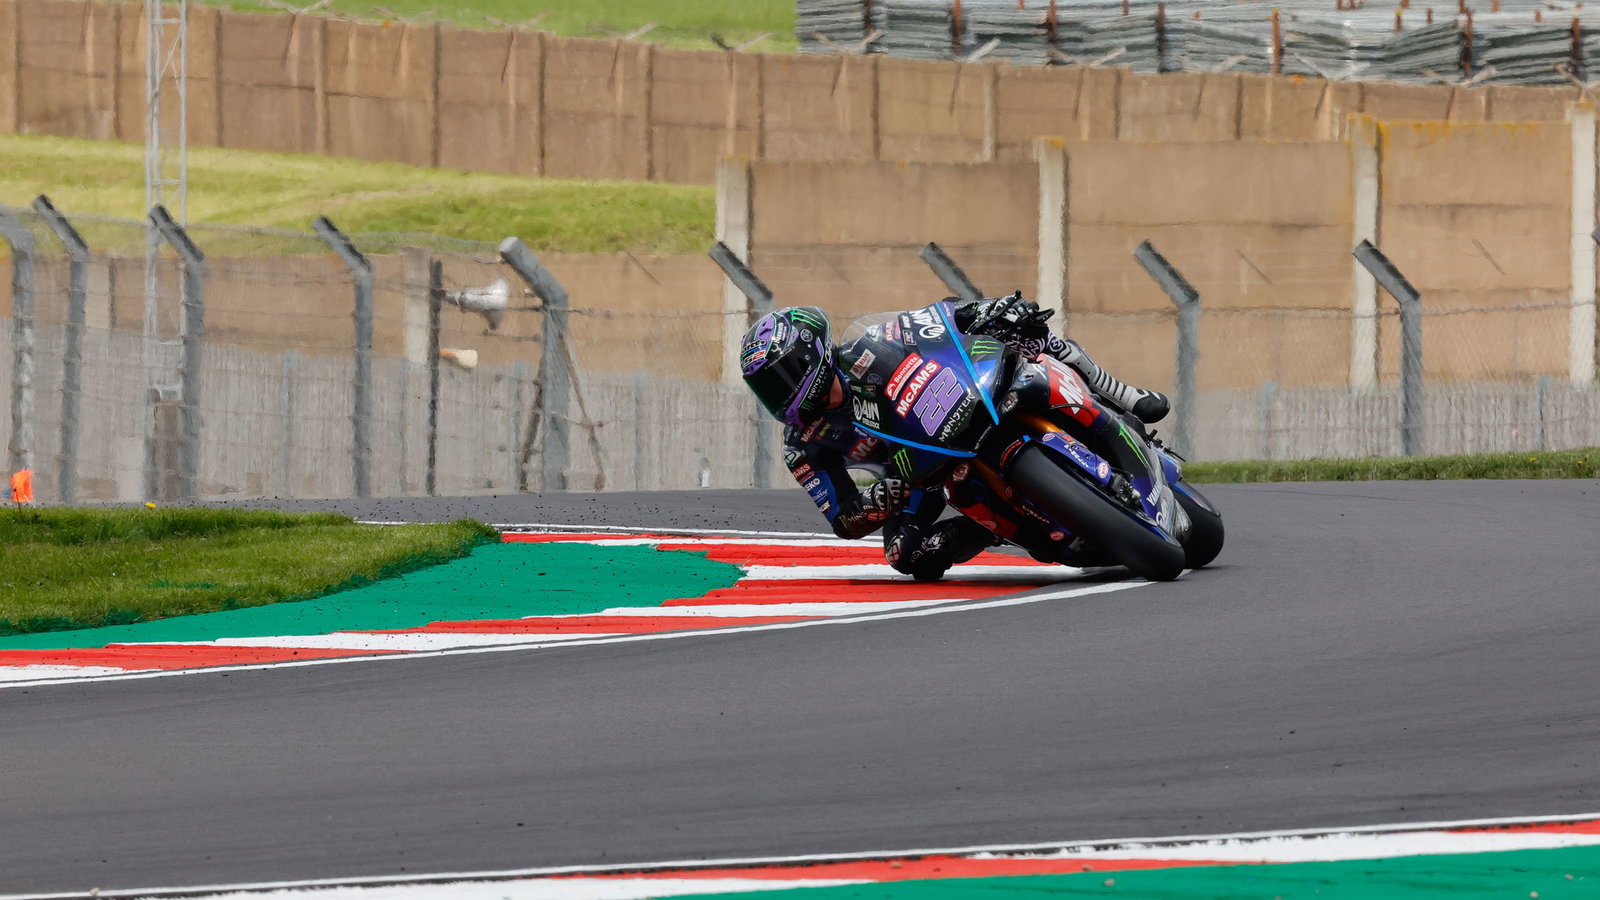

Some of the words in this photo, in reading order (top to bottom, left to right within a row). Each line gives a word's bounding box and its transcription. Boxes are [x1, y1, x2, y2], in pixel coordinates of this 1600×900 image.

[808, 365, 827, 400] MONSTER
[894, 356, 918, 383] Bennetts
[896, 362, 937, 415] McAMS
[912, 366, 964, 437] 22
[939, 392, 976, 442] MONSTER
